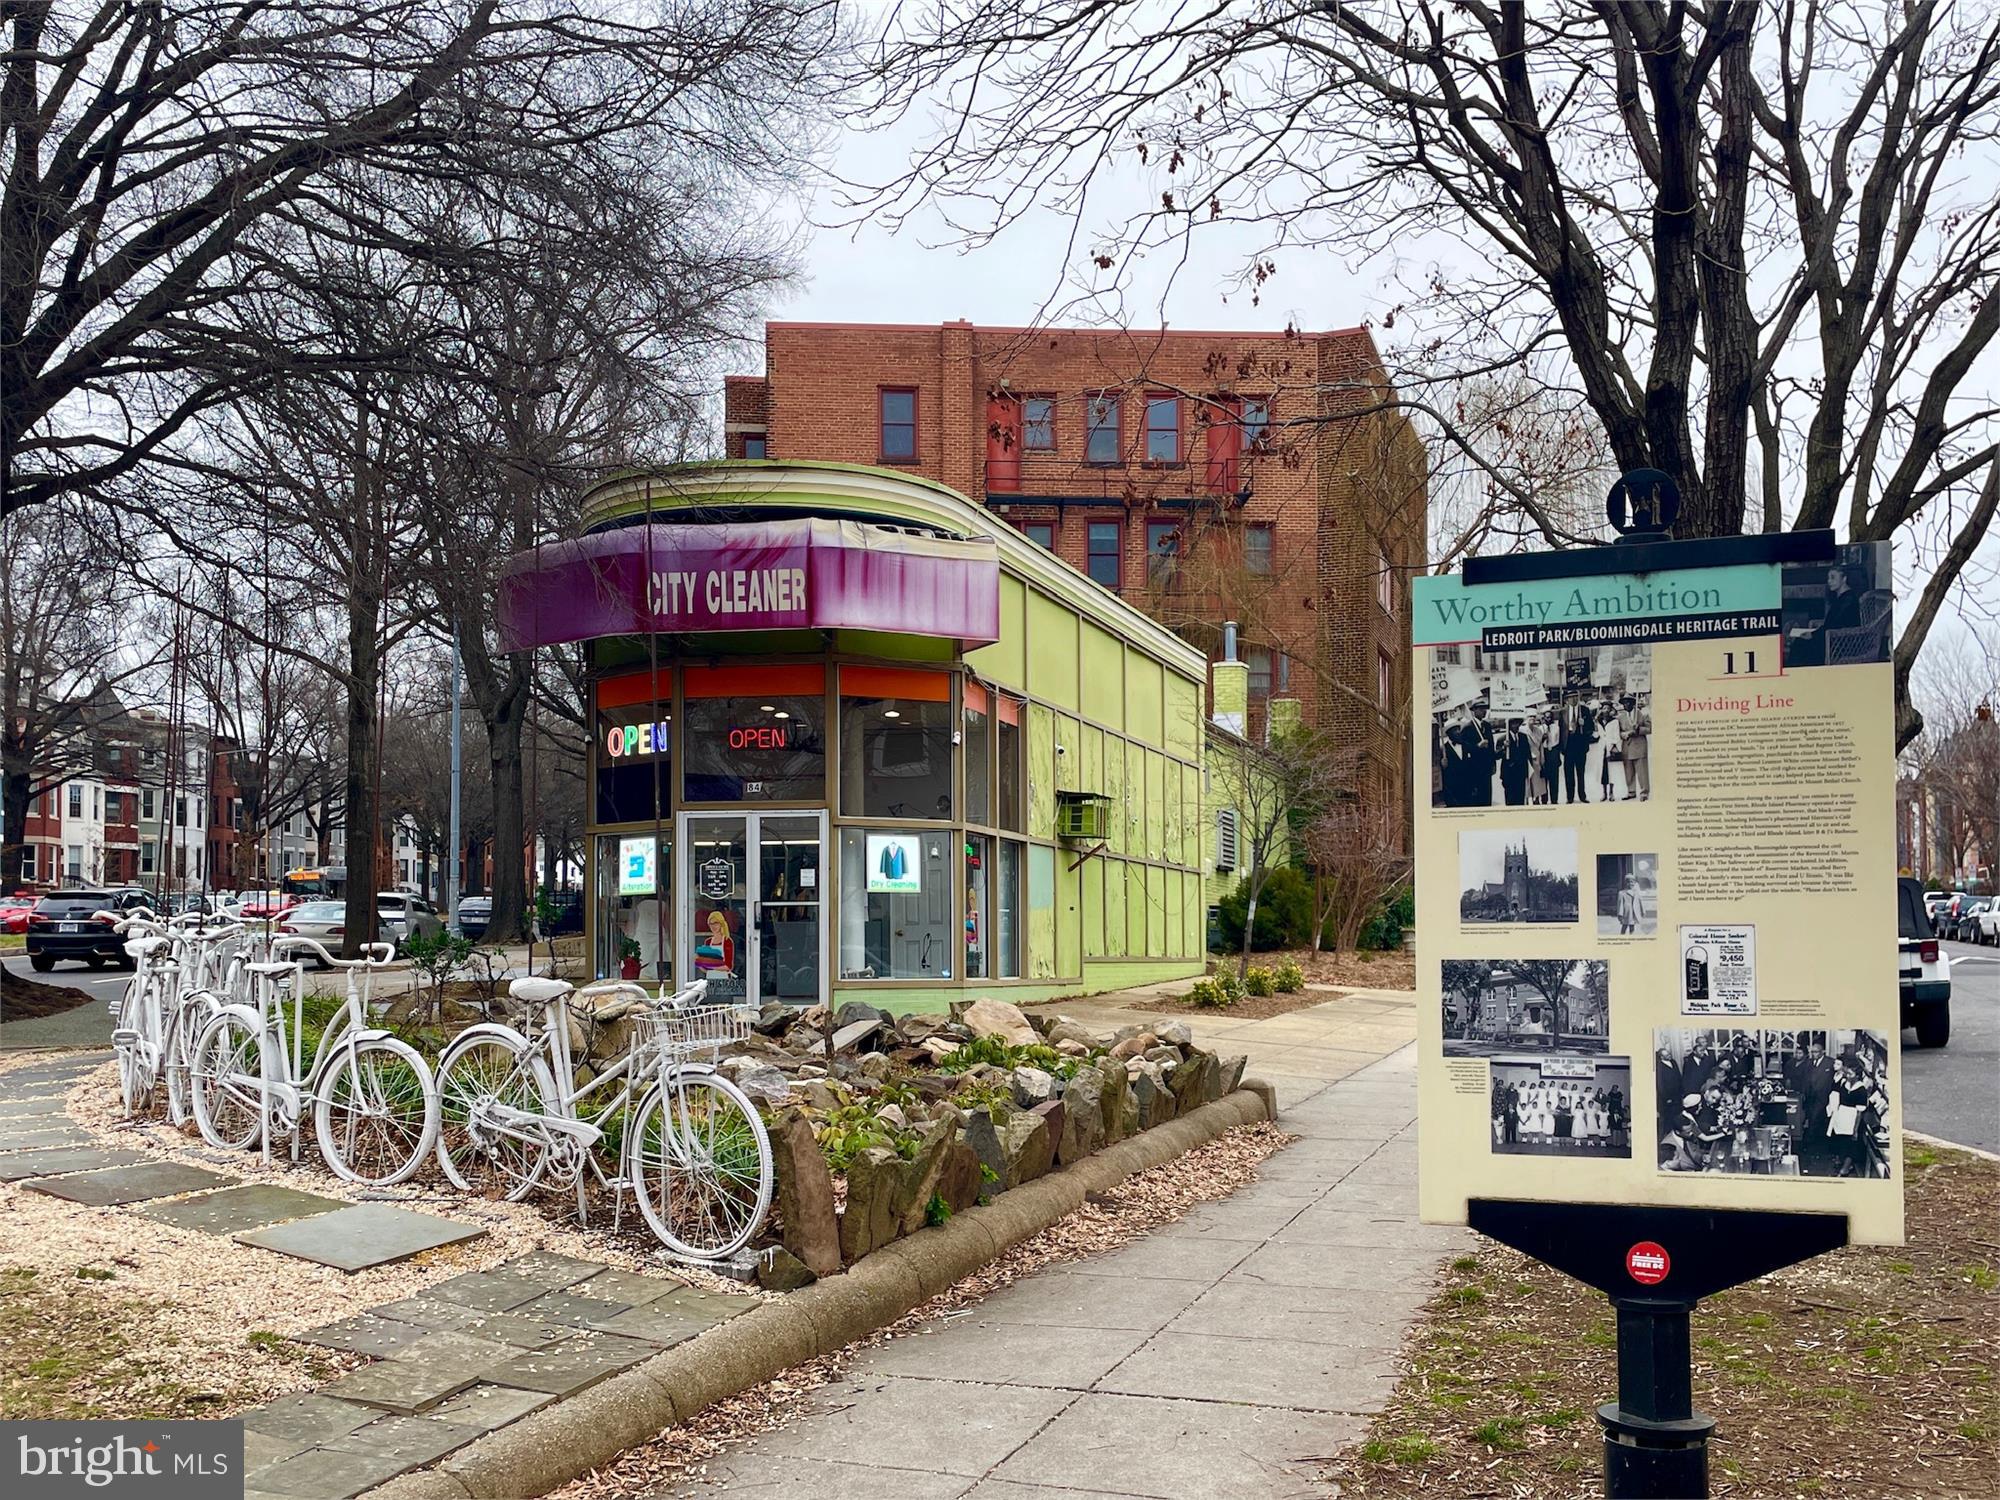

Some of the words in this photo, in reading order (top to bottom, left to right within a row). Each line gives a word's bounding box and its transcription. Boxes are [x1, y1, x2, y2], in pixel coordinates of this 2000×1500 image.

[646, 571, 697, 616] CITY
[706, 568, 806, 614] CLEANER
[1432, 592, 1553, 628] Worthy
[1563, 582, 1720, 617] Ambition
[1485, 631, 1535, 646] LEDROIT
[1539, 622, 1673, 643] PARK/BLOOMINGDALE
[1676, 618, 1738, 634] HERITAGE
[1742, 616, 1779, 630] TRAIL
[1723, 651, 1759, 675] 11
[1677, 696, 1751, 715] Dividing
[1756, 694, 1795, 709] Line
[607, 721, 668, 757] OPEN
[729, 728, 785, 748] OPEN
[748, 784, 760, 792] 84
[886, 880, 918, 889] Cleaning
